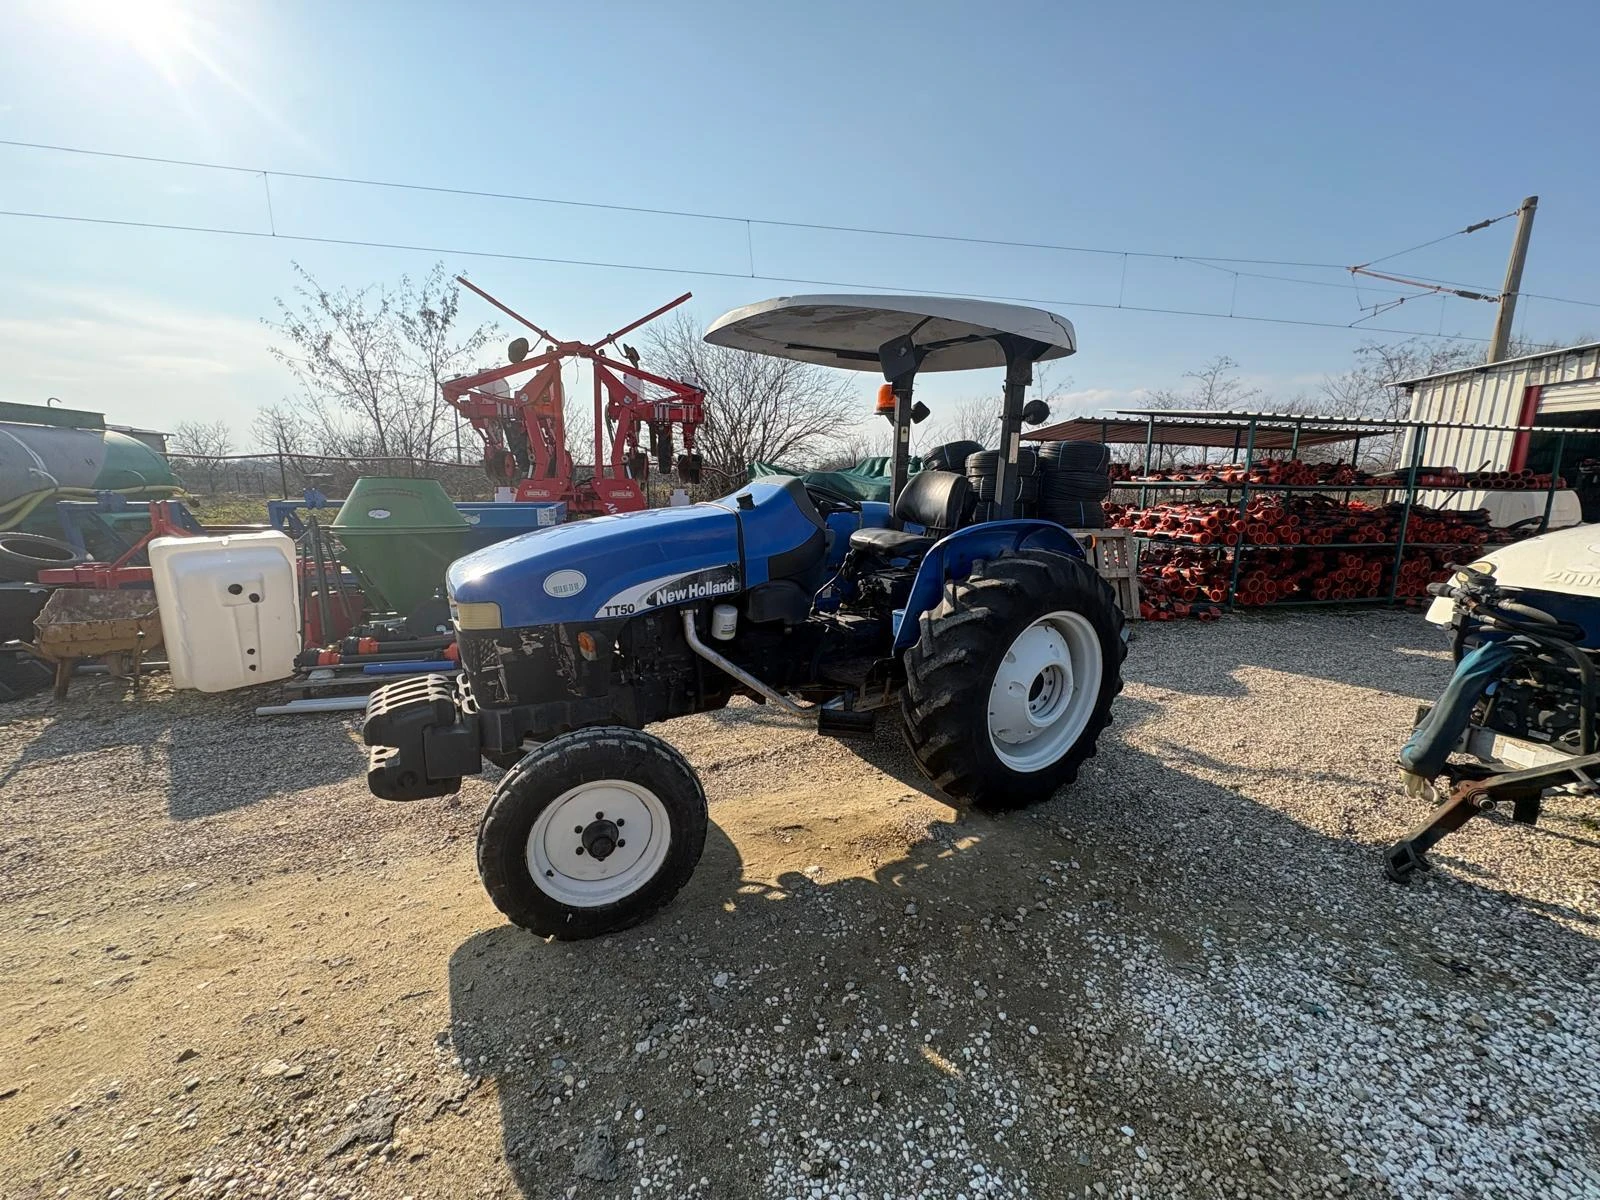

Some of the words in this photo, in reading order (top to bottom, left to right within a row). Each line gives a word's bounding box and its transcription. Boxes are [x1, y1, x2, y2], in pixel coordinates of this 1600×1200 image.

[656, 589, 687, 606] New
[688, 577, 735, 598] Holland
[604, 603, 635, 617] TT50
